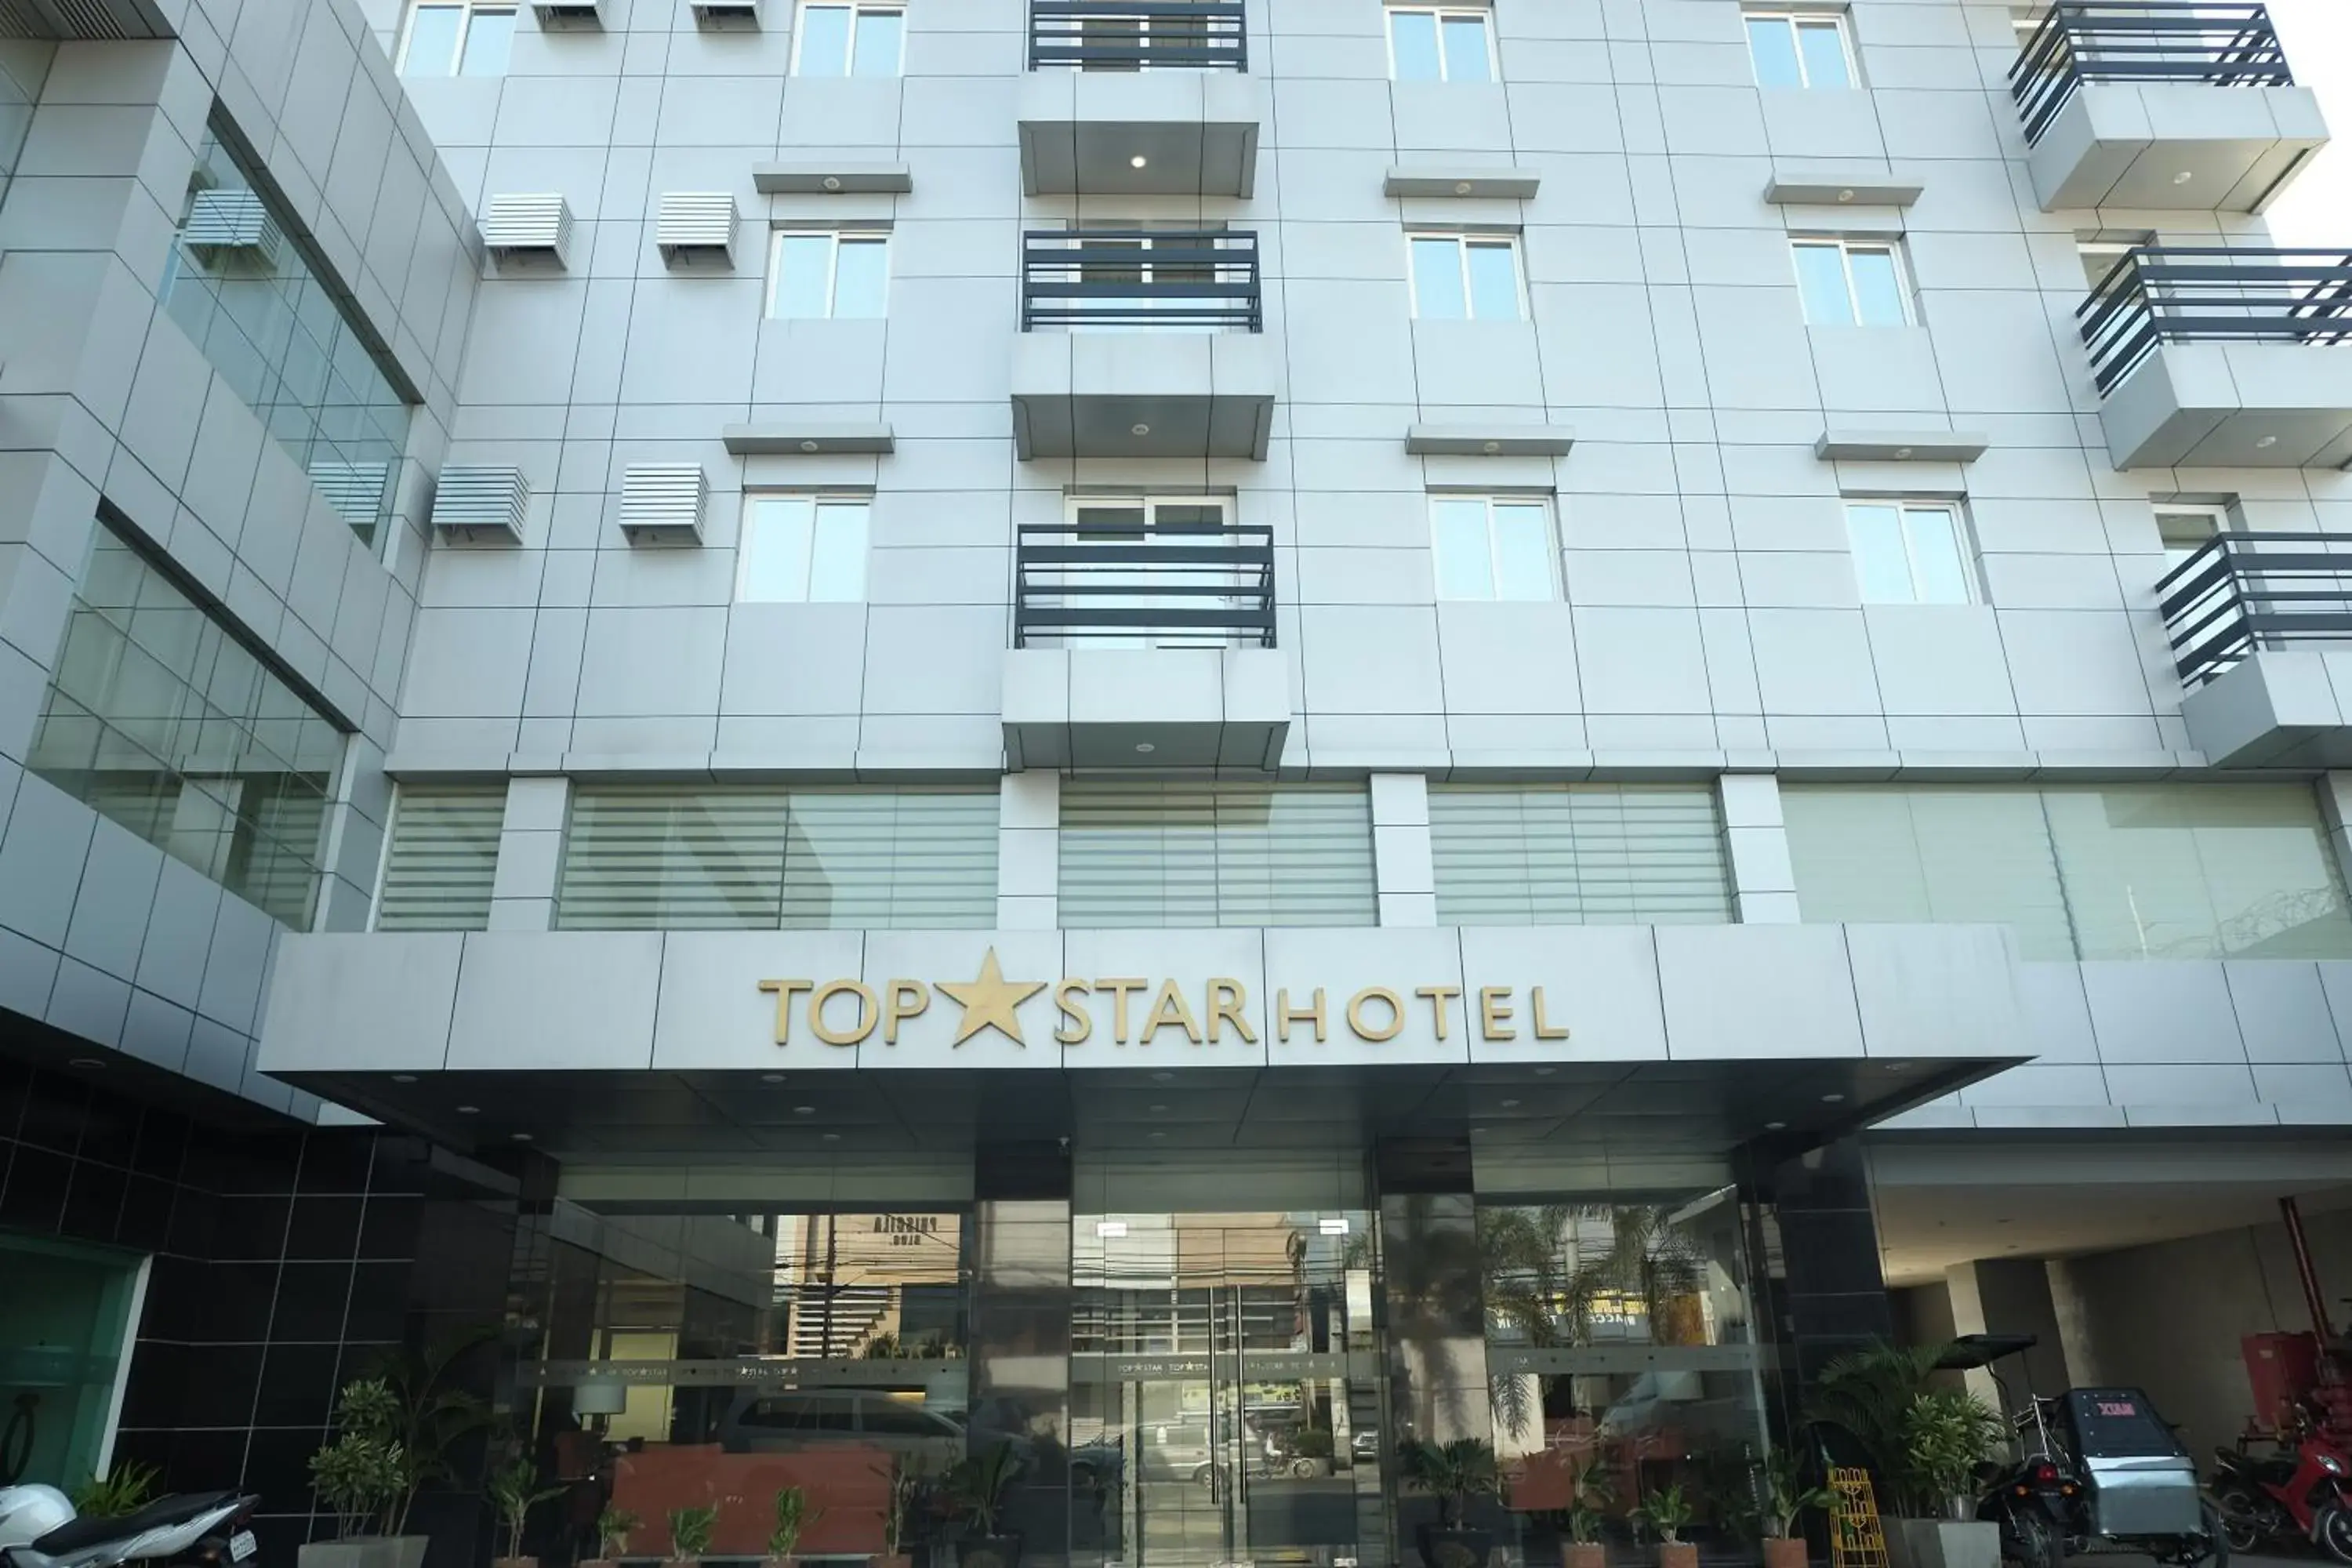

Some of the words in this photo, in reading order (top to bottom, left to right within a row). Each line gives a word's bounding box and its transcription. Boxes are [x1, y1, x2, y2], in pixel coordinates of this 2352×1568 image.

[758, 979, 930, 1046] TOP
[1054, 978, 1258, 1044] STAR
[1277, 986, 1569, 1042] HOTEL
